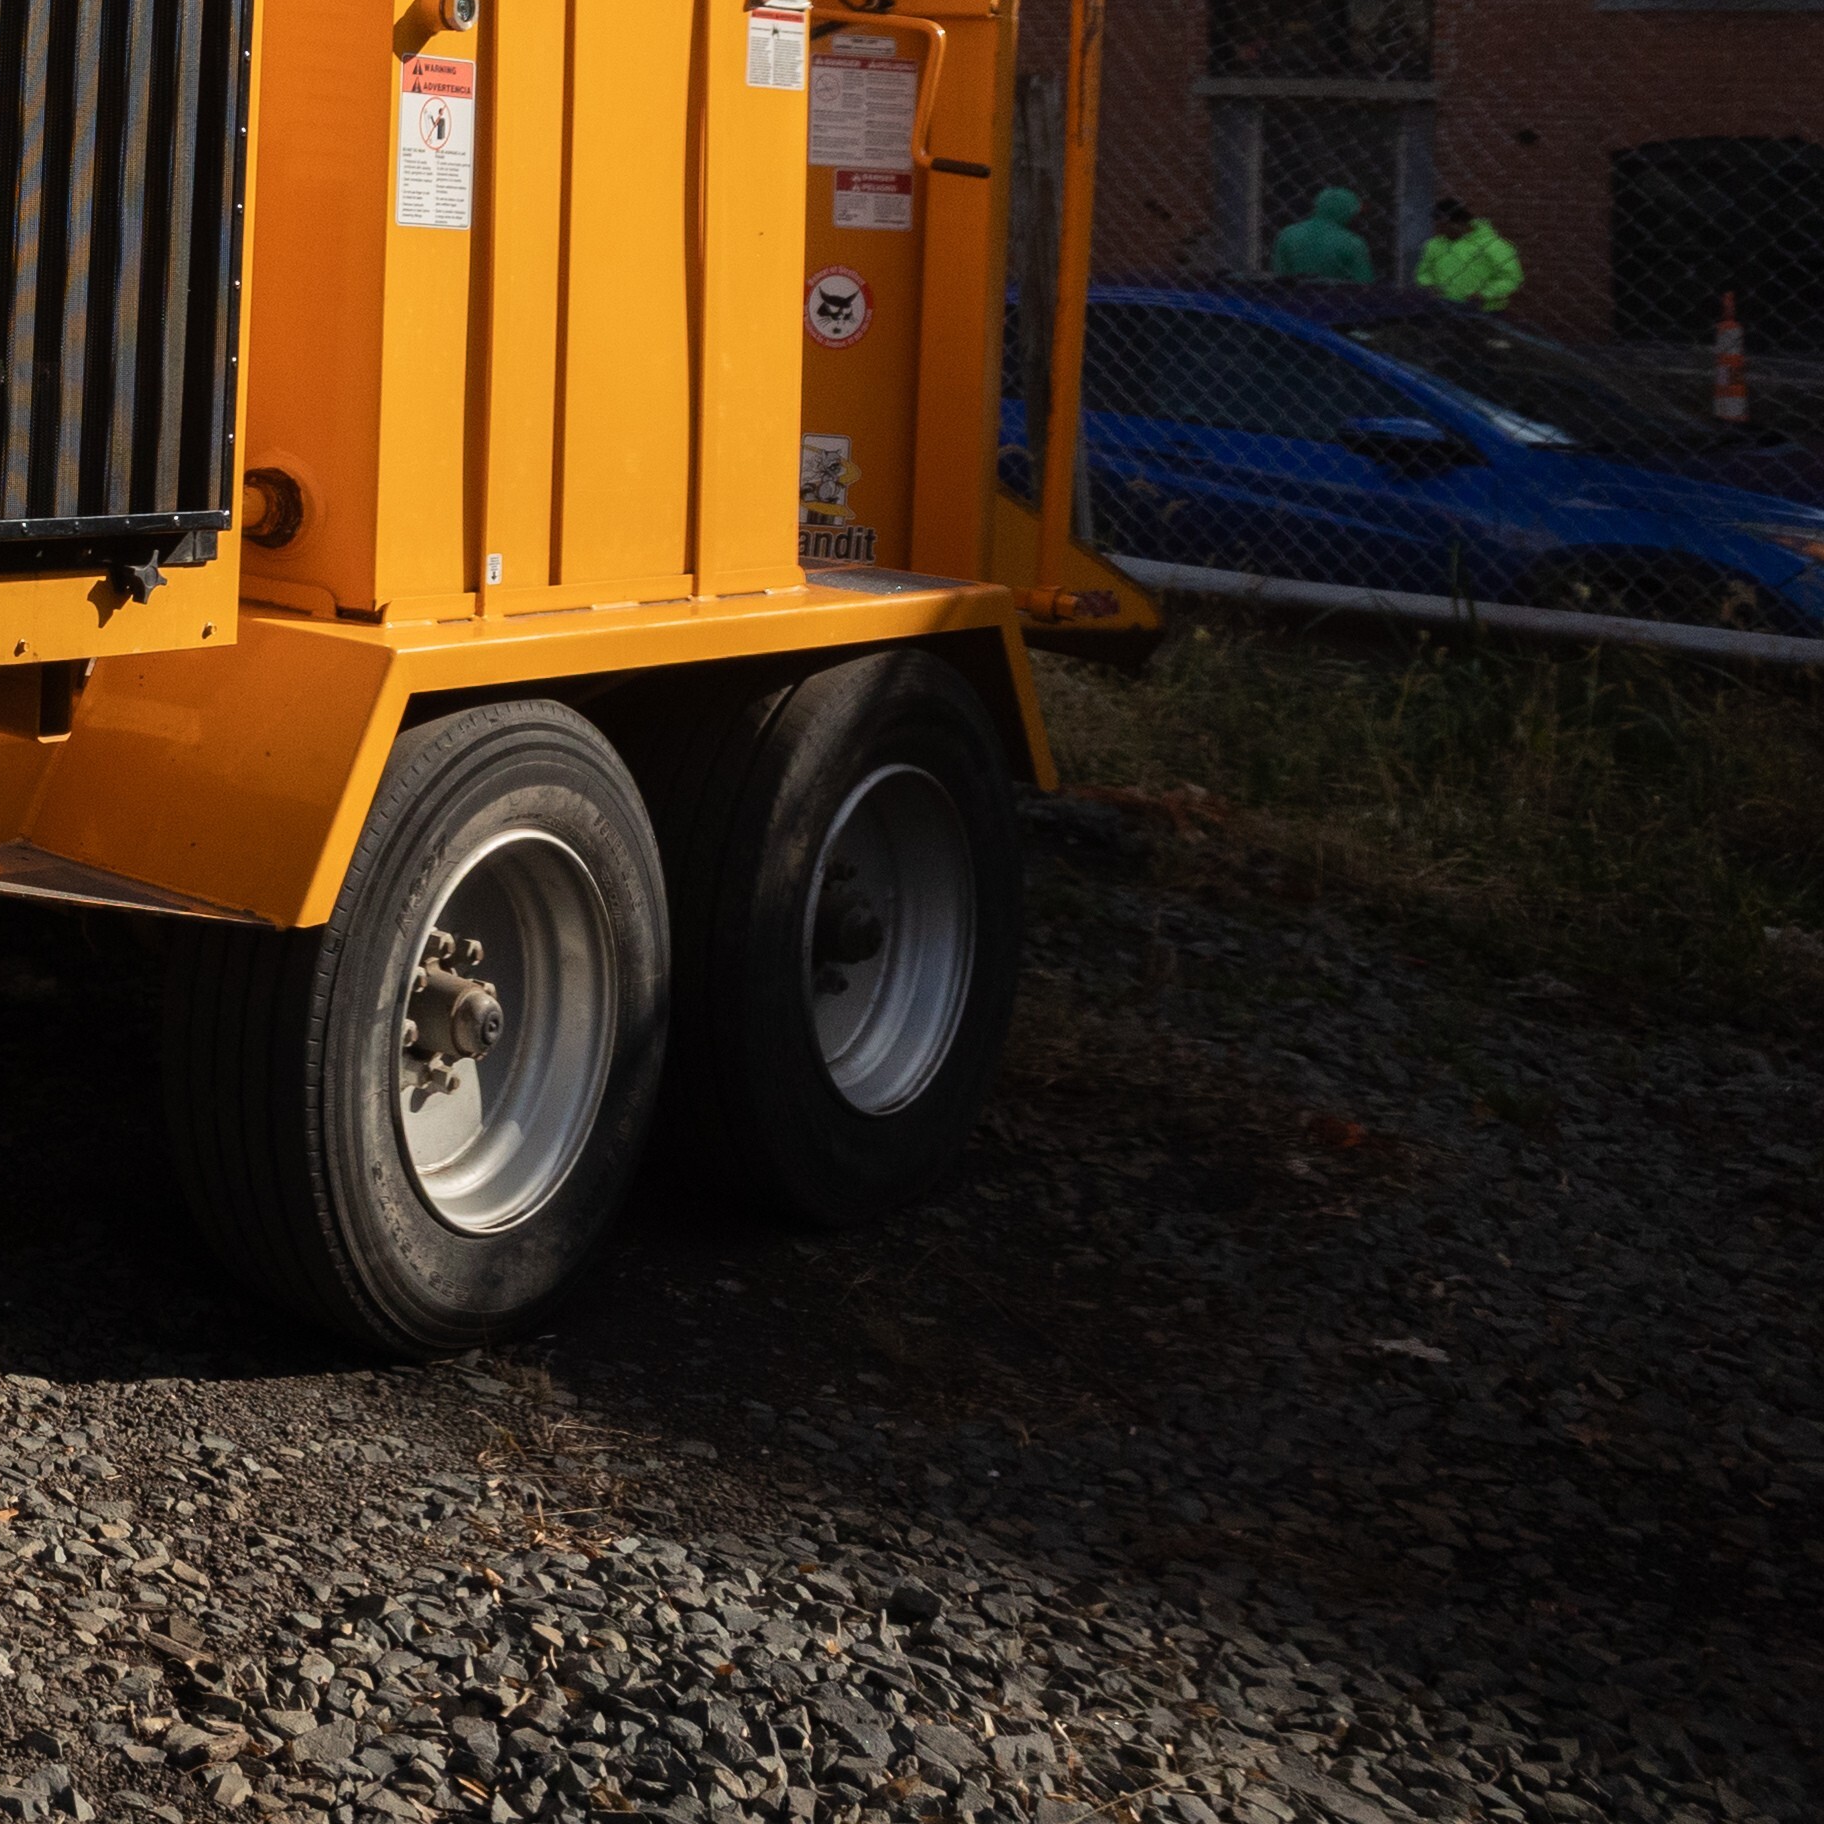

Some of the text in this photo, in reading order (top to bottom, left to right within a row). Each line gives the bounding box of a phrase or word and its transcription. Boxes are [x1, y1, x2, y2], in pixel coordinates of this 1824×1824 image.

[424, 64, 456, 75] WARNING
[423, 81, 471, 94] ADVERTENCIA
[799, 527, 875, 562] andit
